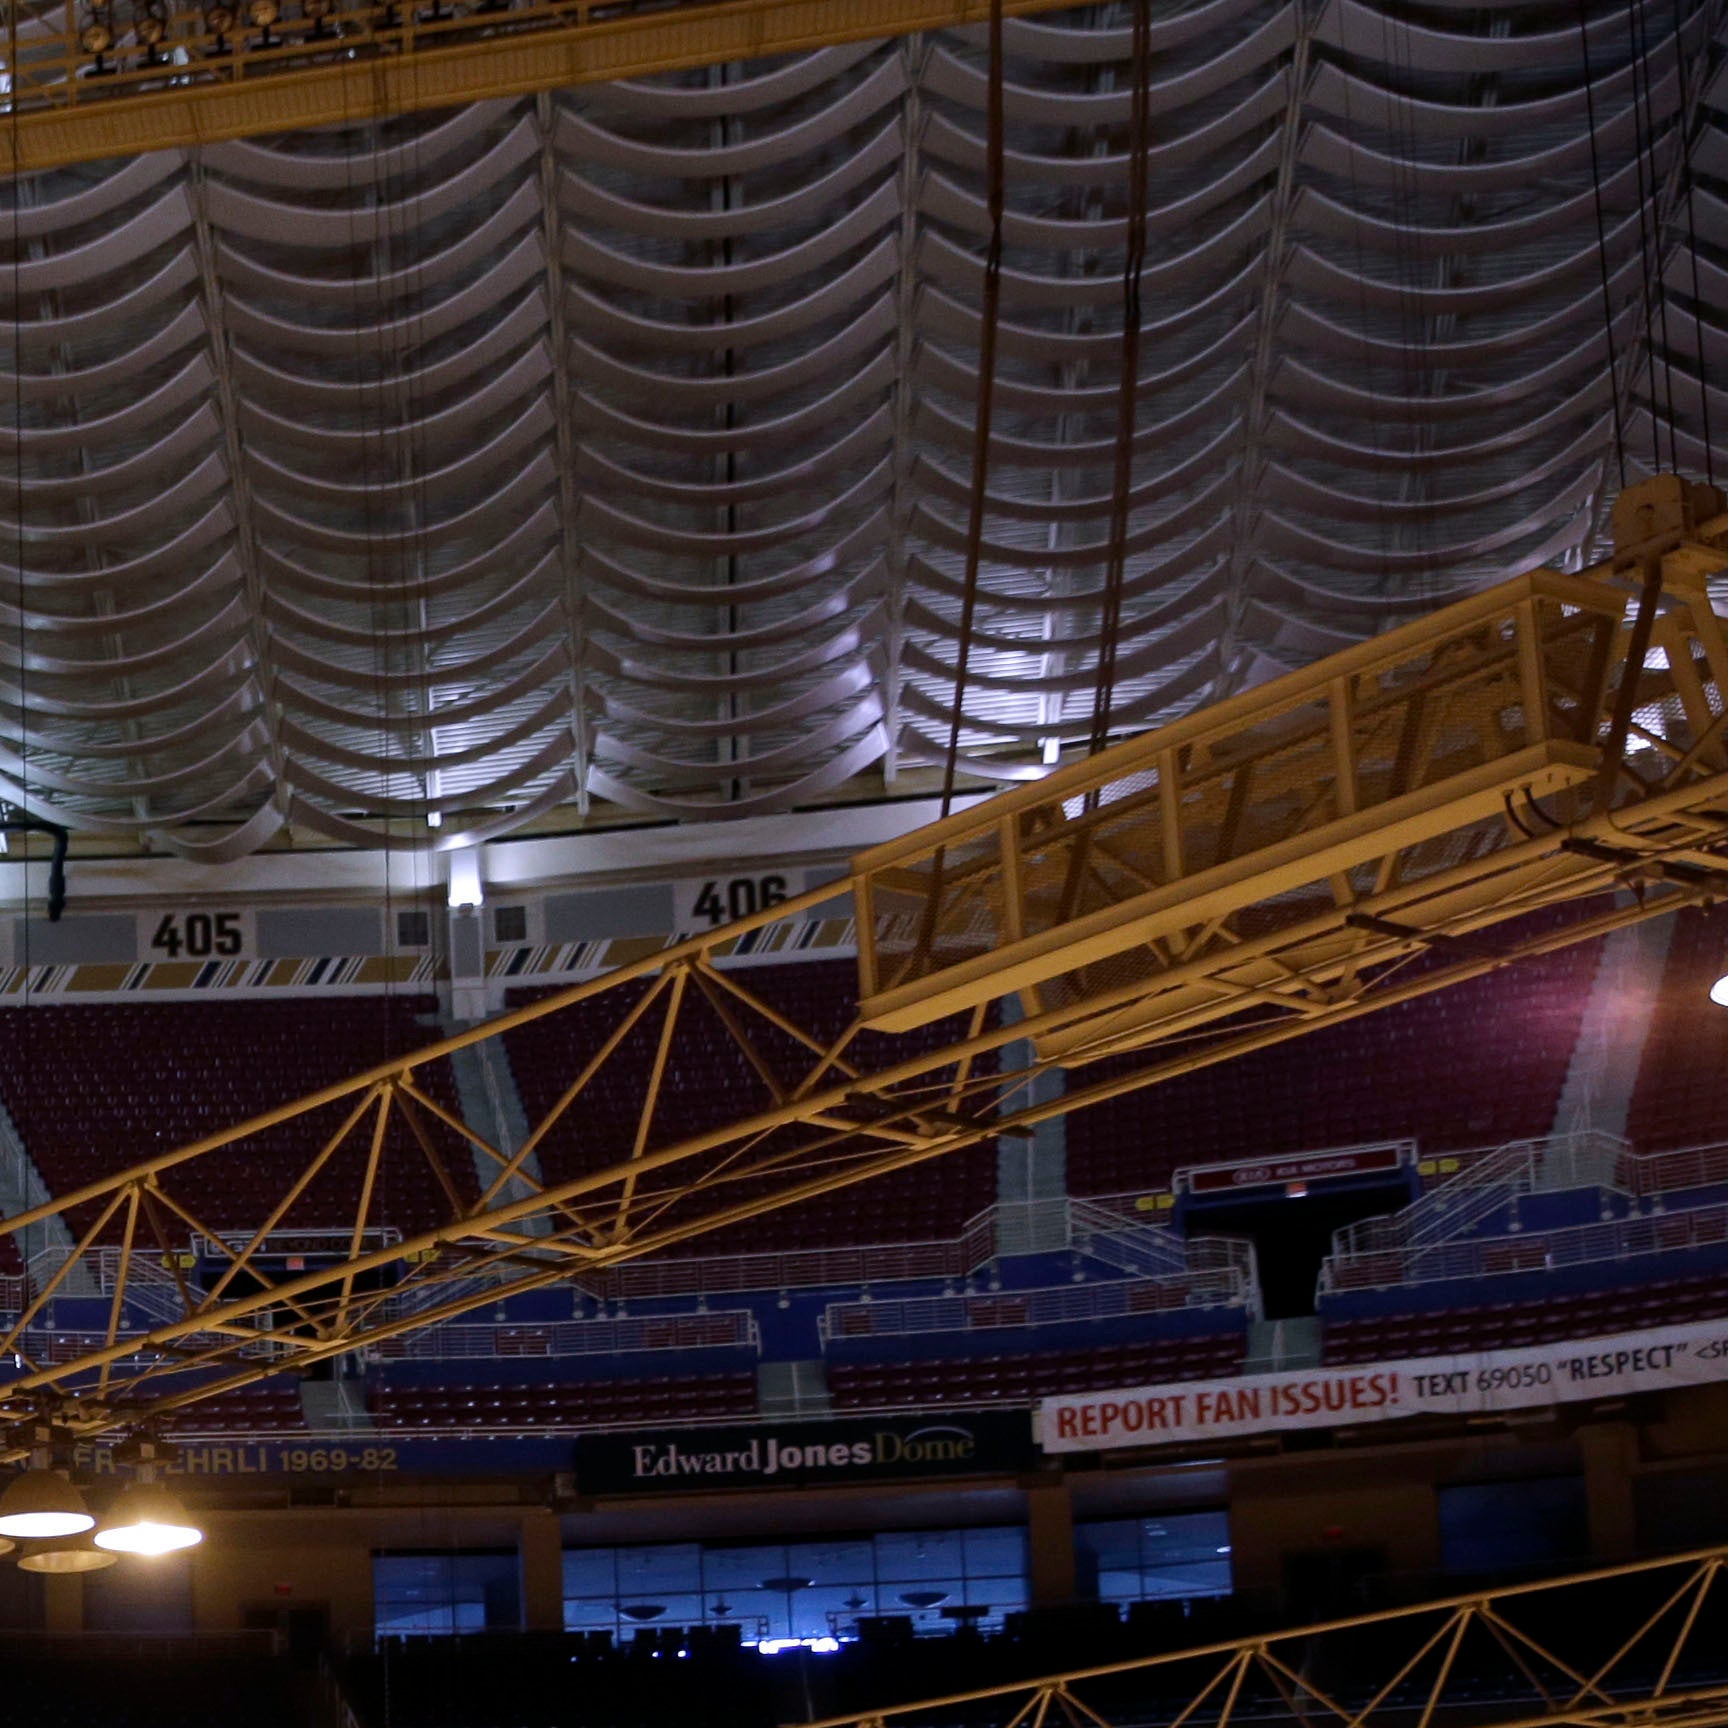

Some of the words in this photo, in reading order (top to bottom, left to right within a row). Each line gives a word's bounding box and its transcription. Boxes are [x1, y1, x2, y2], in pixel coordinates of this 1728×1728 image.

[693, 875, 786, 924] 406
[152, 914, 242, 957] 405
[1057, 1395, 1185, 1439] REPORT
[1197, 1388, 1260, 1426] FAN
[1270, 1373, 1398, 1417] ISSUES!
[1414, 1369, 1468, 1399] TEXT
[1477, 1363, 1552, 1393] 69050
[280, 1447, 398, 1472] 1969-82
